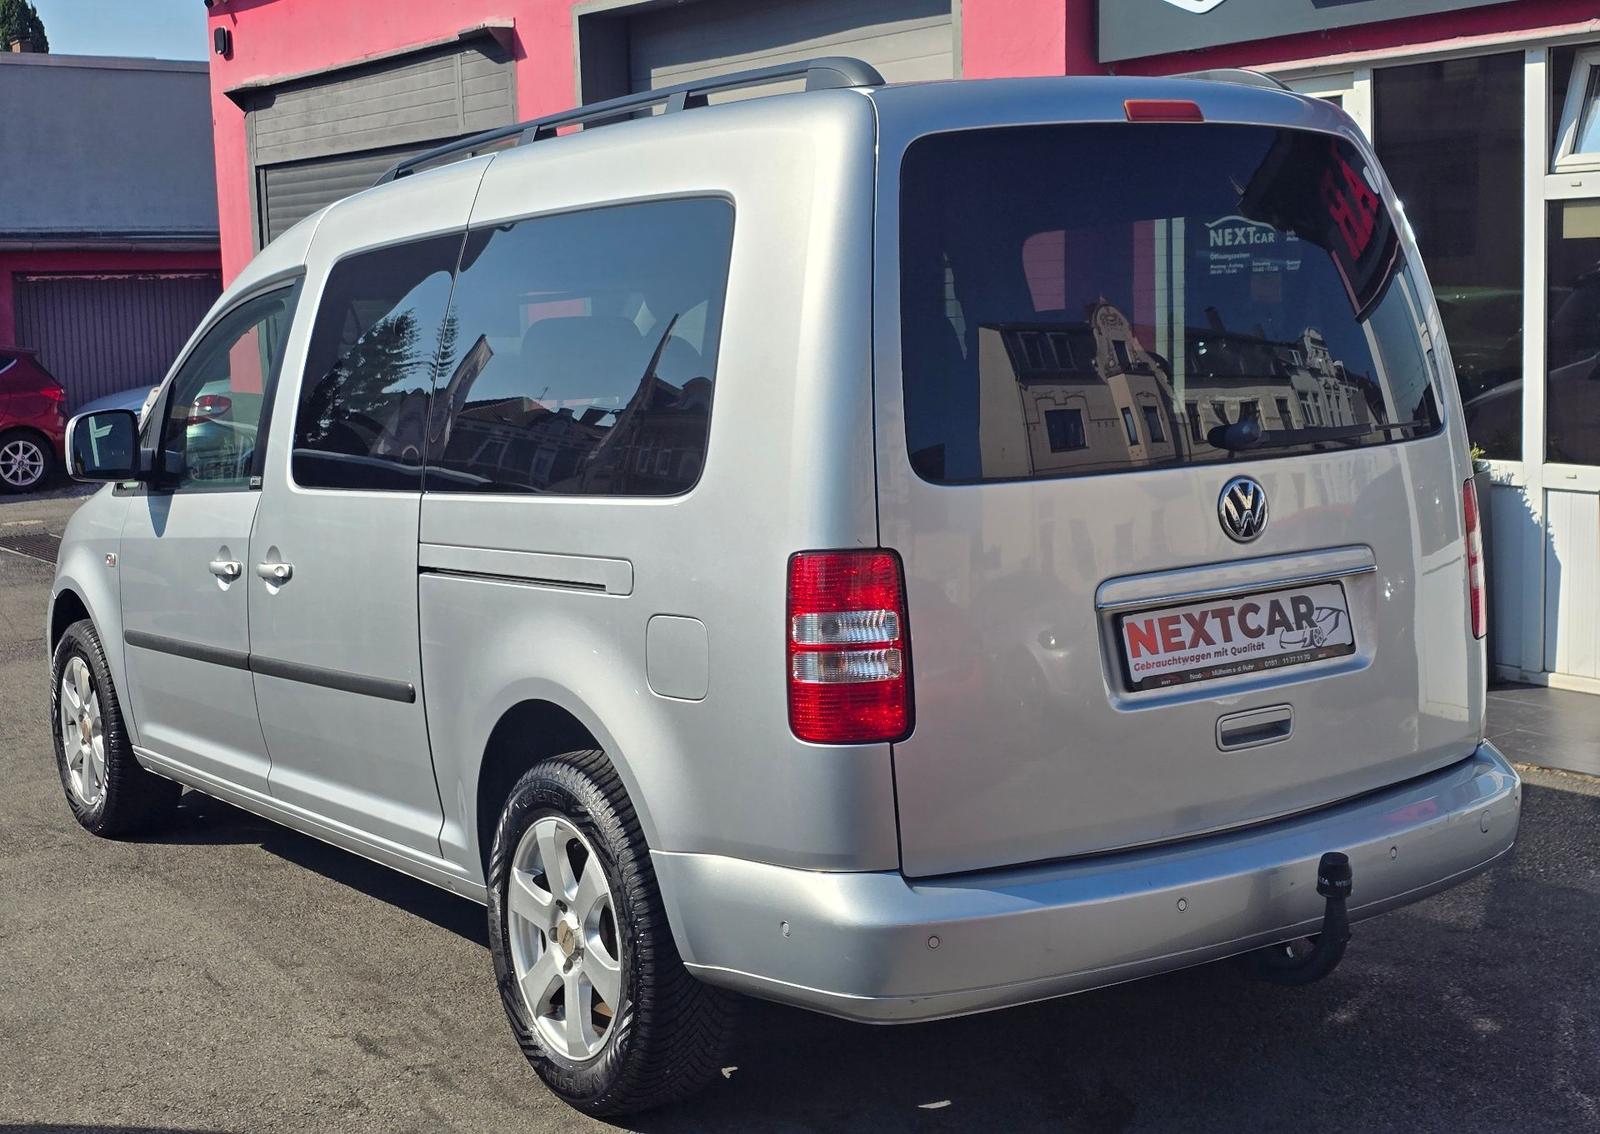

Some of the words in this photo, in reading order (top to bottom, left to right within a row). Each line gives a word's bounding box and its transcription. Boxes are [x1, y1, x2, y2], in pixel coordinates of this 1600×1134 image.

[1219, 477, 1267, 541] VW
[1125, 595, 1319, 659] NEXTCAR
[1133, 653, 1212, 672] Gebrauchtwagen
[1214, 648, 1228, 658] mit
[1230, 642, 1265, 656] Qualität
